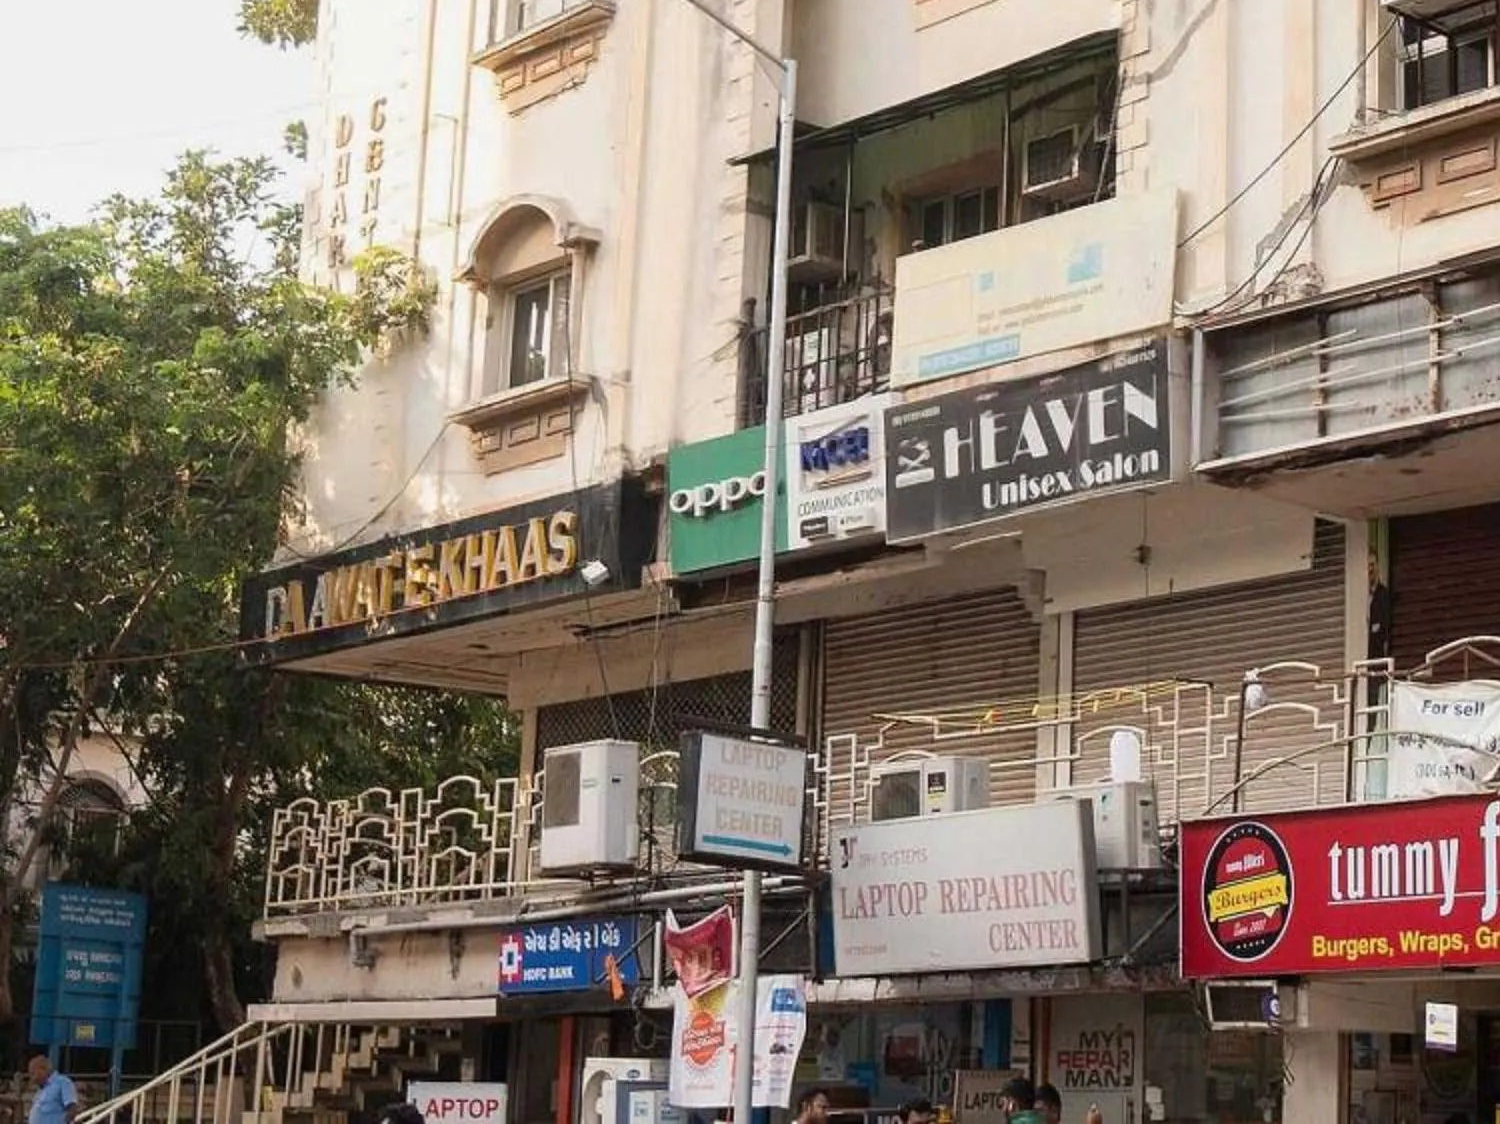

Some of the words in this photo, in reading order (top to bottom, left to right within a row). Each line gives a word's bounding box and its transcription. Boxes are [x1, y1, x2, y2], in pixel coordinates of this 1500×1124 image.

[943, 373, 1158, 478] HEAVEN
[981, 470, 1073, 510] Unisex
[1079, 448, 1160, 488] Salon
[1421, 699, 1449, 716] For
[1453, 700, 1485, 717] sell
[720, 740, 788, 773] LAPTOP
[839, 879, 929, 921] LAPTOP
[939, 868, 1077, 915] REPAIRING
[1327, 839, 1459, 917] tummy
[988, 918, 1080, 954] CENTER
[1311, 934, 1395, 962] Burgers,
[1399, 931, 1470, 956] Wraps,
[1064, 1067, 1122, 1088] MAN
[964, 1089, 1004, 1112] LAPTO
